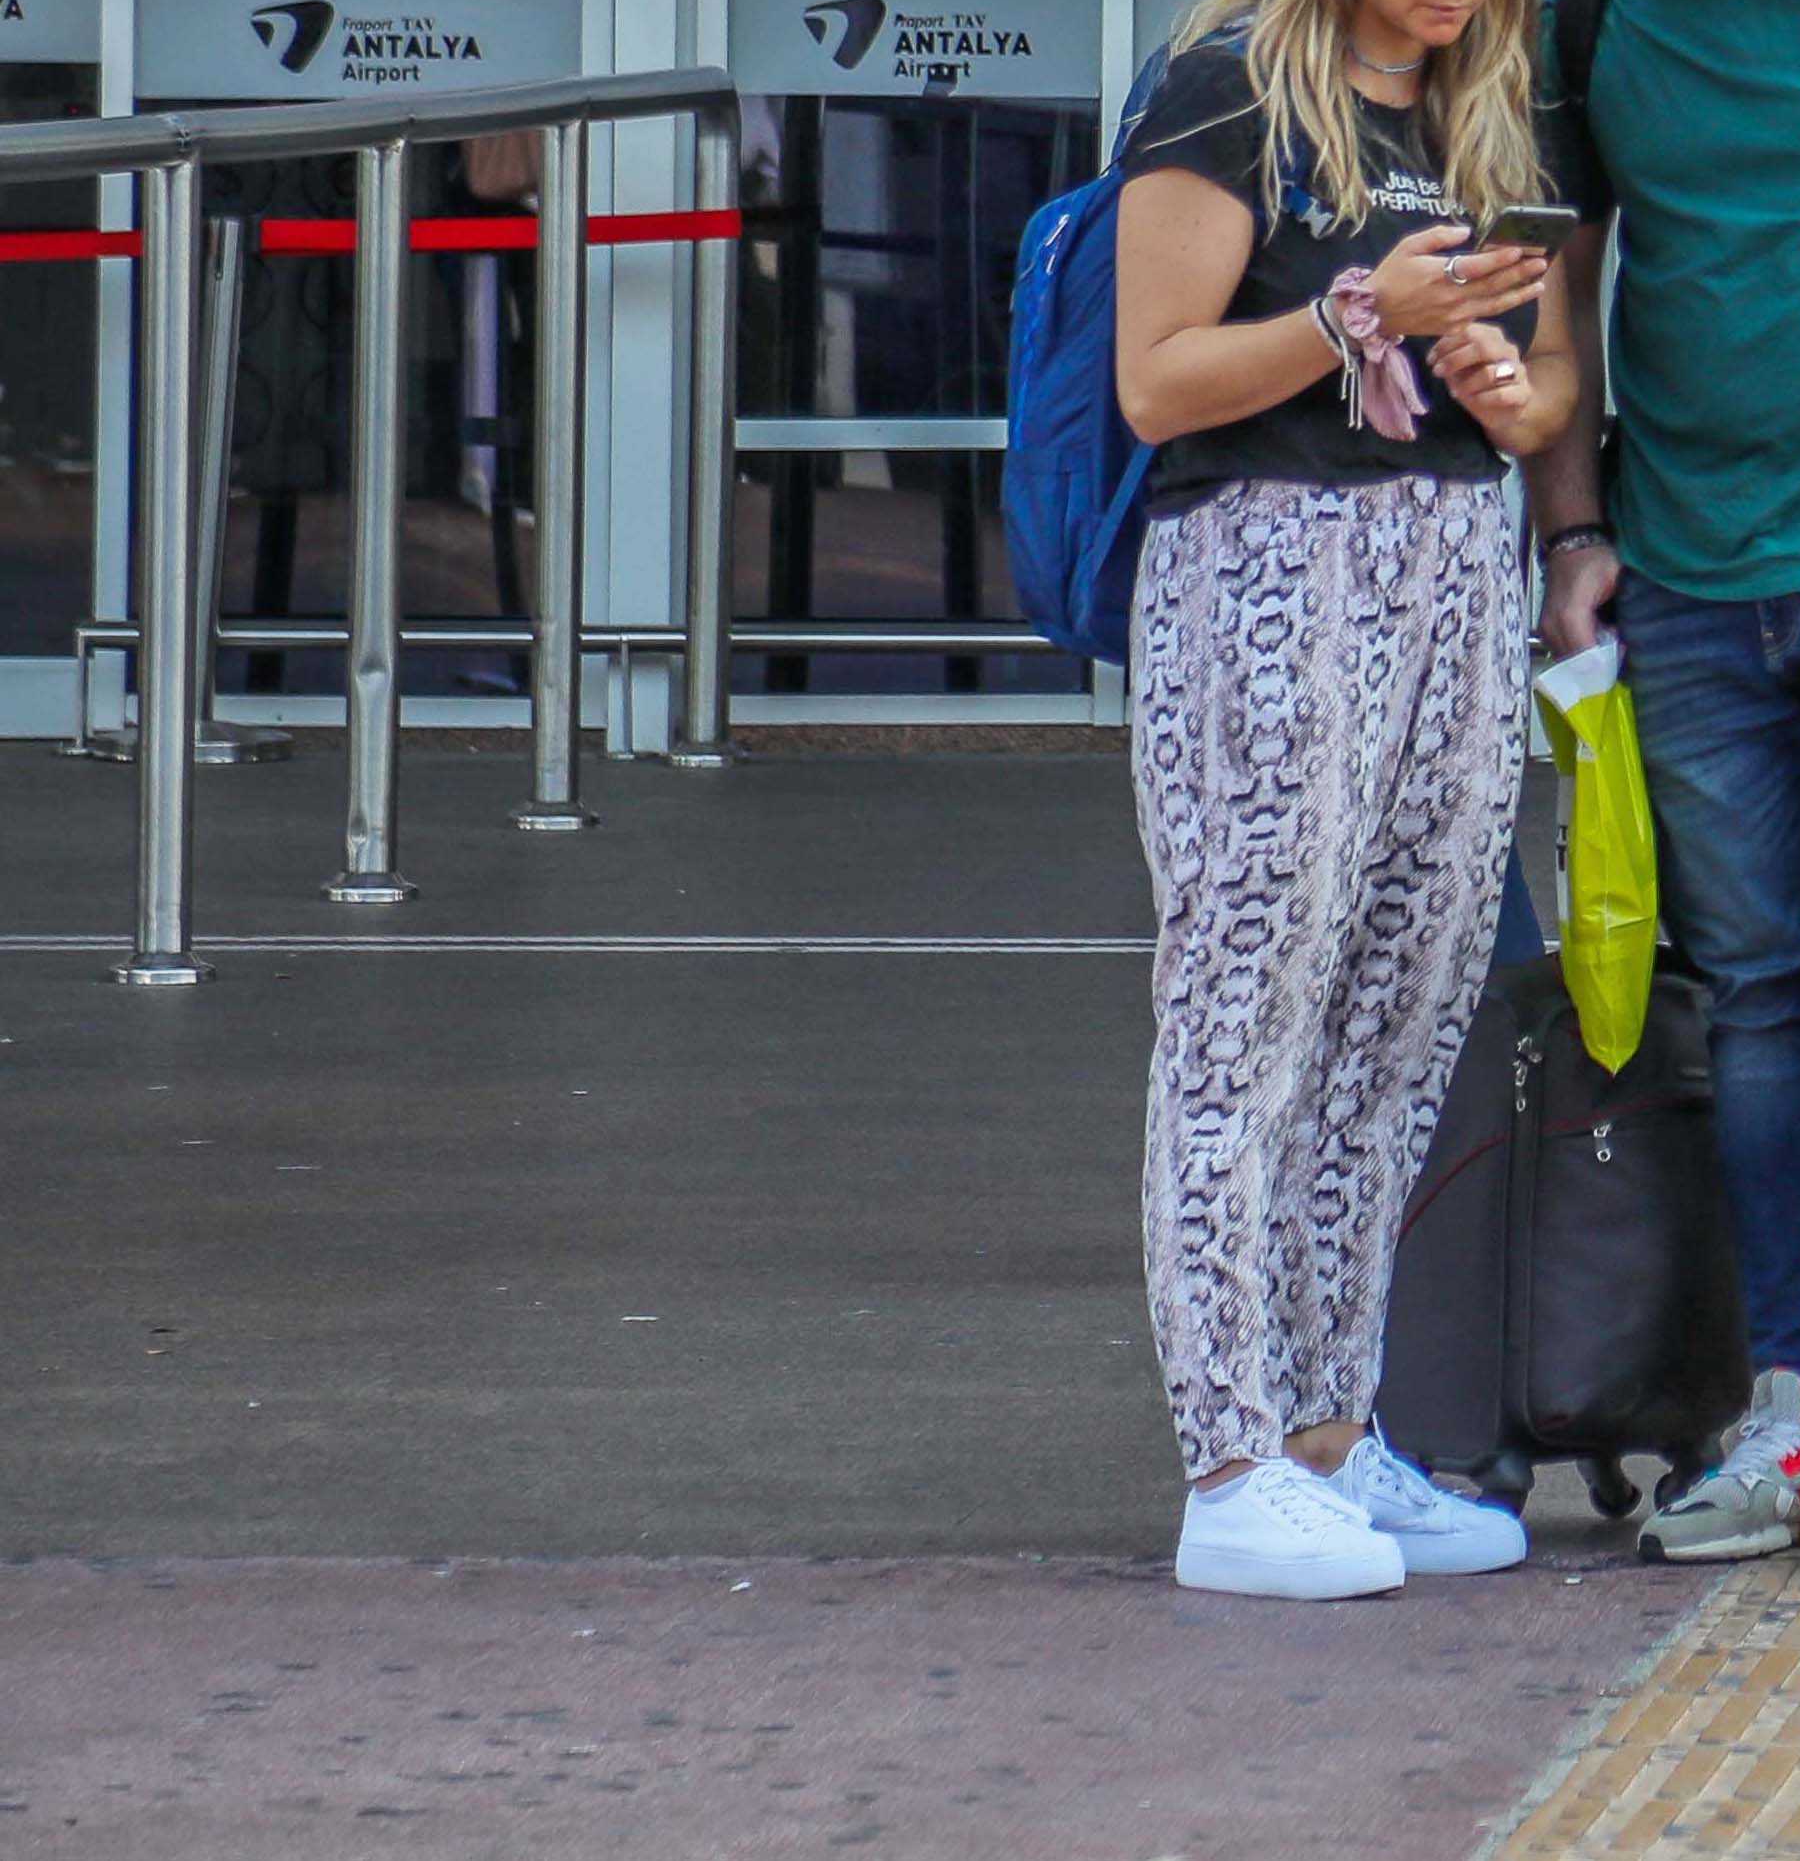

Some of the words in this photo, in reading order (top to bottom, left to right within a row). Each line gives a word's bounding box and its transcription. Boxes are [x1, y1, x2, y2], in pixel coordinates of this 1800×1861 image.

[342, 17, 393, 36] Fraport
[401, 18, 436, 31] TAV
[952, 14, 987, 28] TAV
[342, 34, 482, 60] ANTALYA
[894, 31, 1032, 56] ANTALYA
[342, 62, 420, 84] Airport
